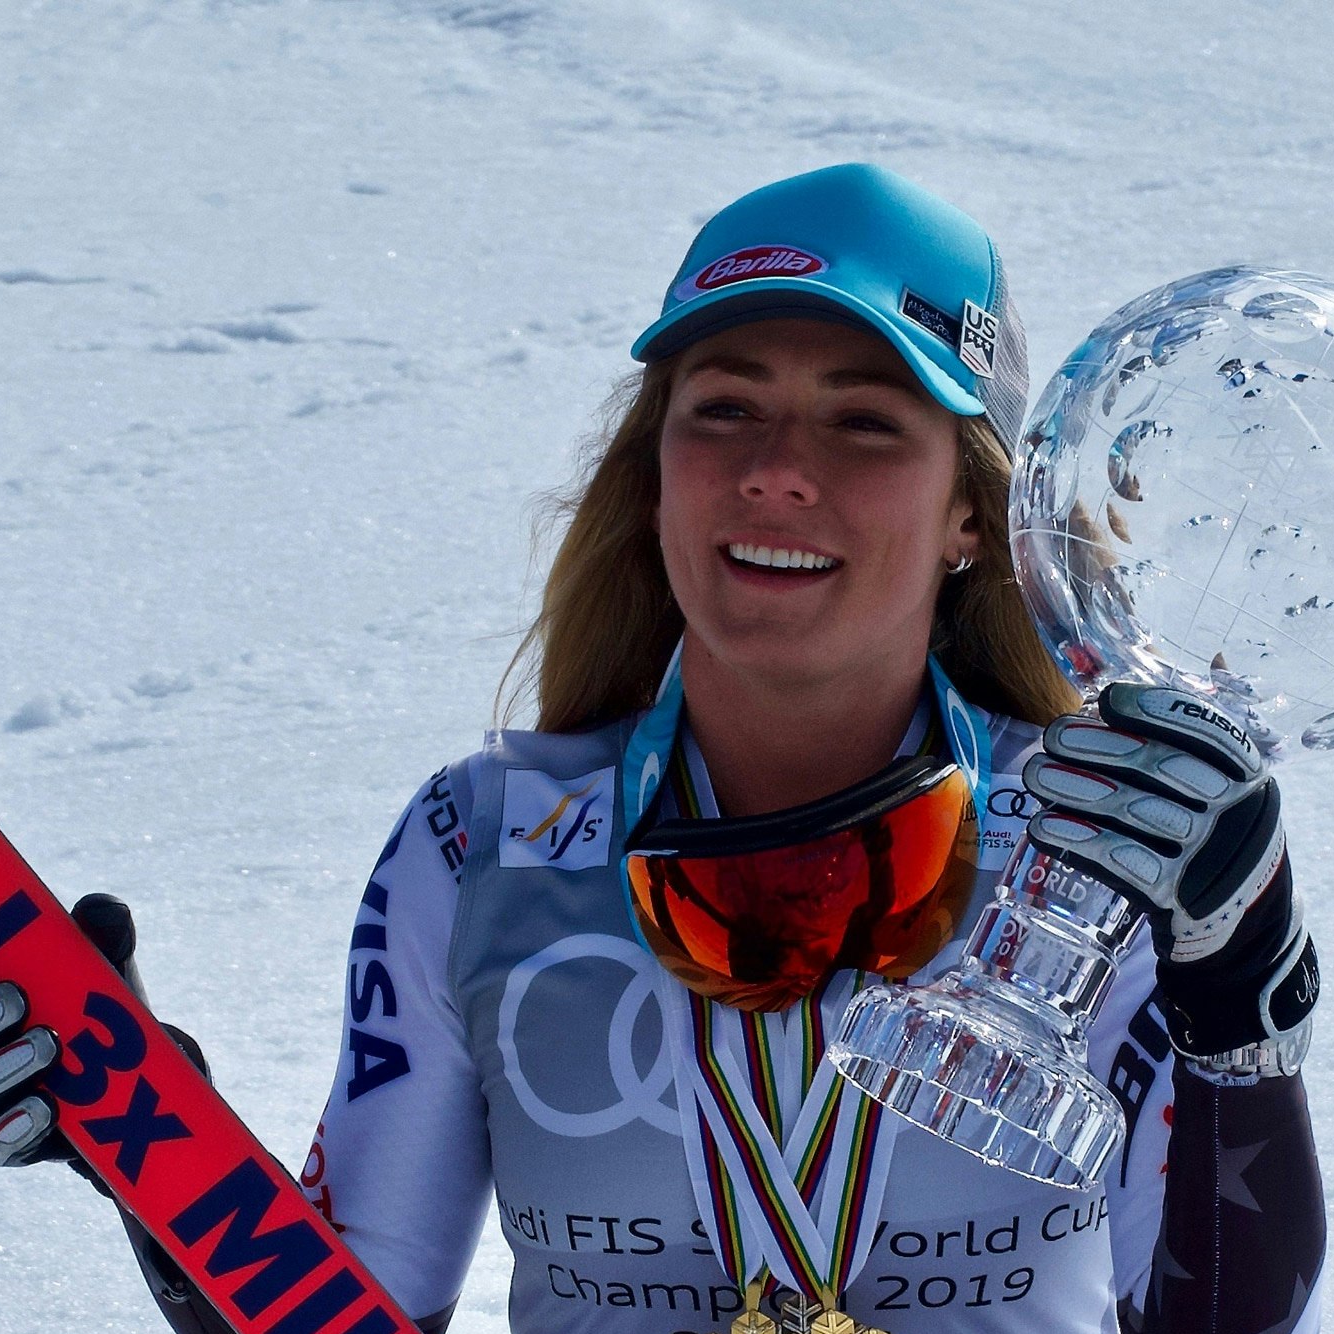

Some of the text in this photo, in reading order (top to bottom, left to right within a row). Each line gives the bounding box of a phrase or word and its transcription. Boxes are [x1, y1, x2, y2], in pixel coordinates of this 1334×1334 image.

[704, 251, 811, 284] Barilla
[966, 304, 997, 341] US
[1169, 700, 1251, 753] reusch
[982, 830, 1011, 839] Audi
[347, 806, 414, 1103] VISA
[43, 991, 194, 1188] 3x
[501, 1200, 551, 1247] udi
[566, 1213, 666, 1256] FIS
[874, 1267, 1035, 1311] 2019
